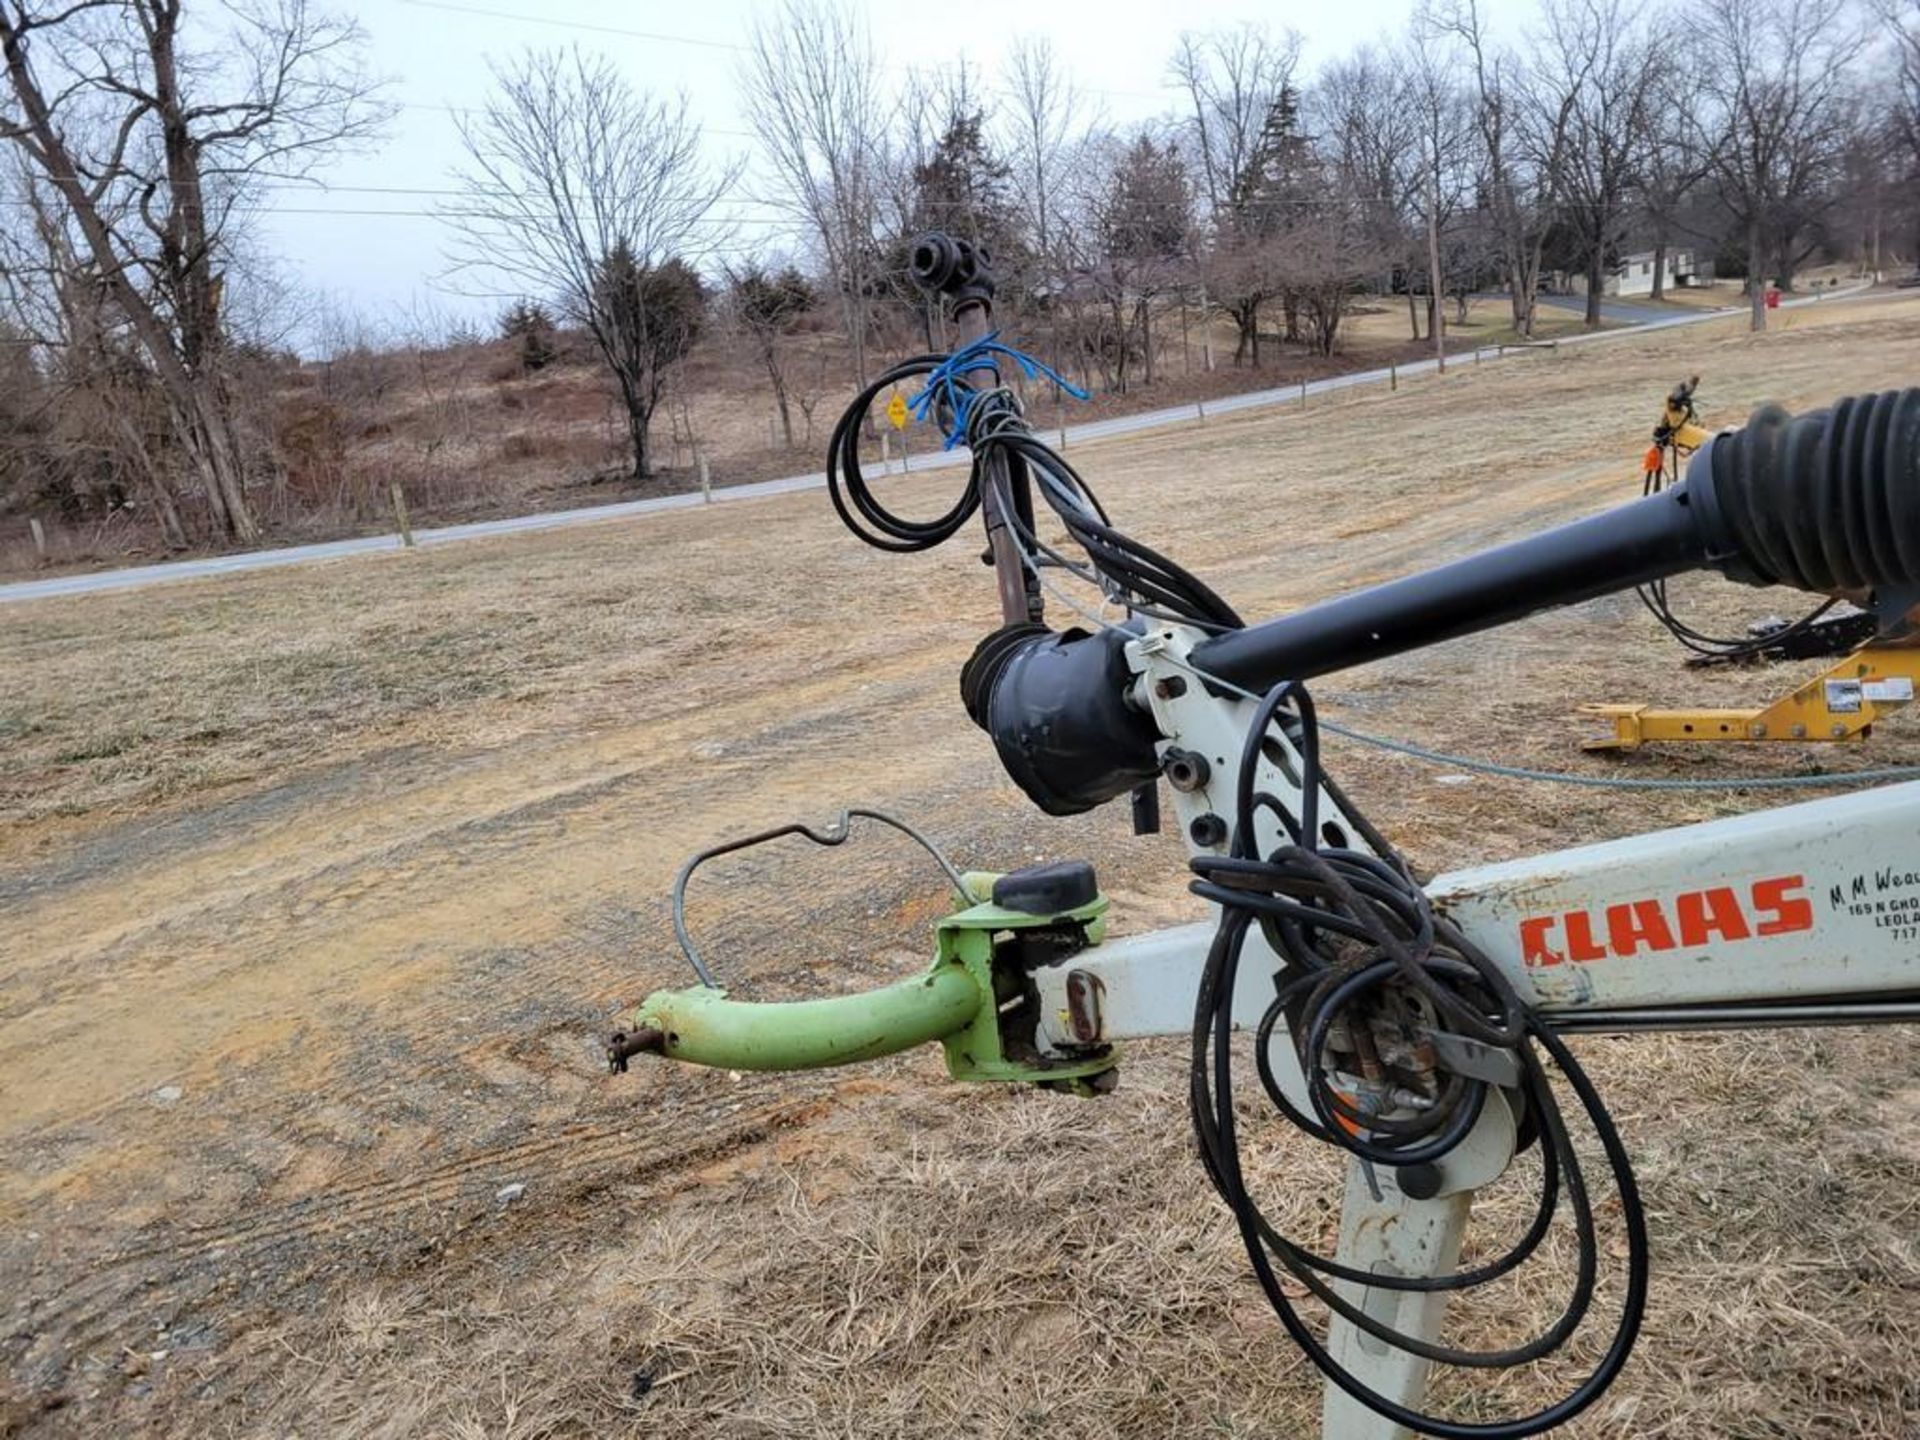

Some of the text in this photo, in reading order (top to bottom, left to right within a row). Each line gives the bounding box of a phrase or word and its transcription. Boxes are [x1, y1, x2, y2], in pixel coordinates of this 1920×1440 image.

[1829, 885, 1846, 911] M
[1852, 875, 1868, 900] M
[1520, 875, 1812, 967] CLAAS
[1849, 903, 1872, 916] 169
[1876, 902, 1885, 913] N
[1891, 927, 1917, 940] 717
